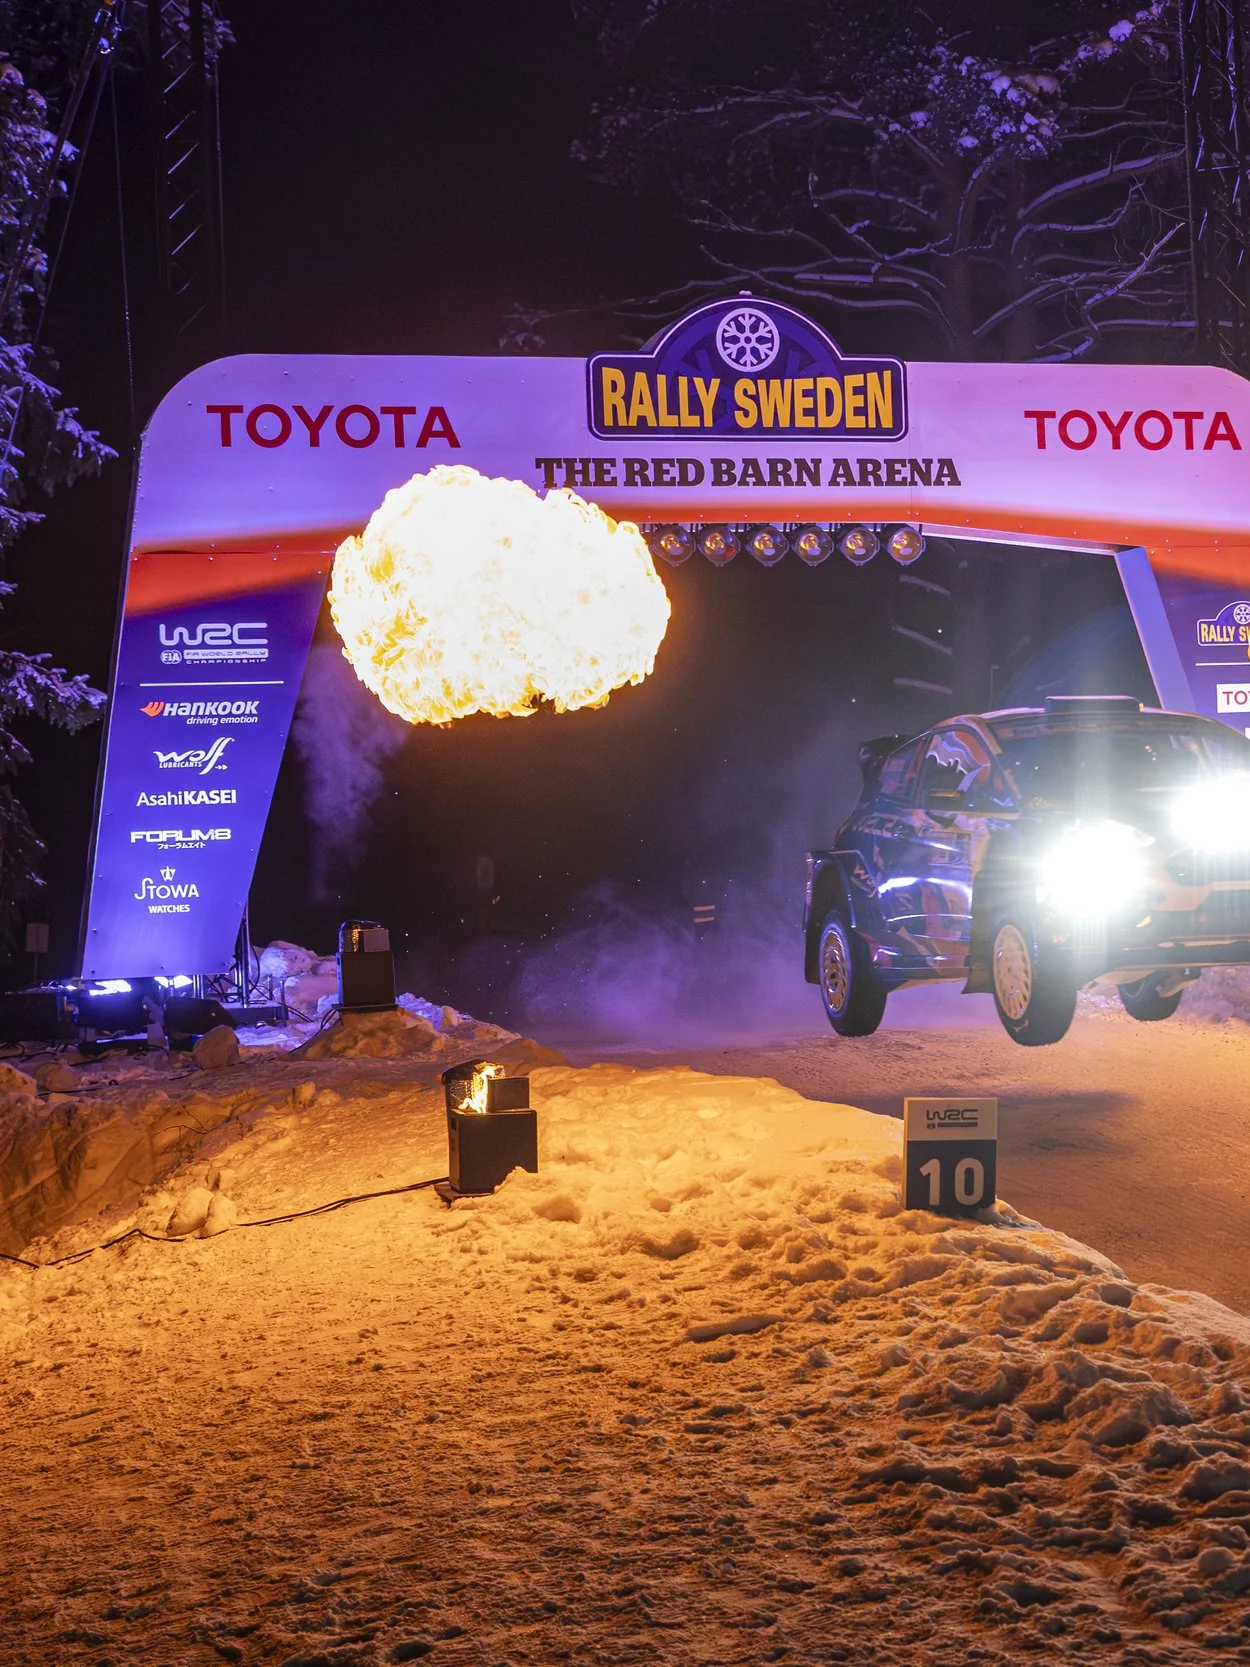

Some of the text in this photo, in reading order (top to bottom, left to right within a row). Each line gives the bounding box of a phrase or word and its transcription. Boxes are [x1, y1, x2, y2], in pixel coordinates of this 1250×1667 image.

[602, 366, 893, 428] RALLY SWEDEN
[206, 404, 461, 448] TOYOTA
[1024, 409, 1242, 450] TOYOTA
[535, 457, 962, 489] THE RED BARN ARENA
[159, 622, 268, 646] WRC
[1201, 623, 1235, 642] RALLY
[161, 650, 182, 664] FIA
[186, 715, 258, 726] driving emotion
[159, 761, 203, 769] LUBRICANTS
[136, 789, 237, 806] AsahiKASEI
[130, 828, 232, 843] FORUM8
[148, 904, 190, 914] WATCHES
[926, 1109, 978, 1120] WRC
[919, 1157, 985, 1206] 10
